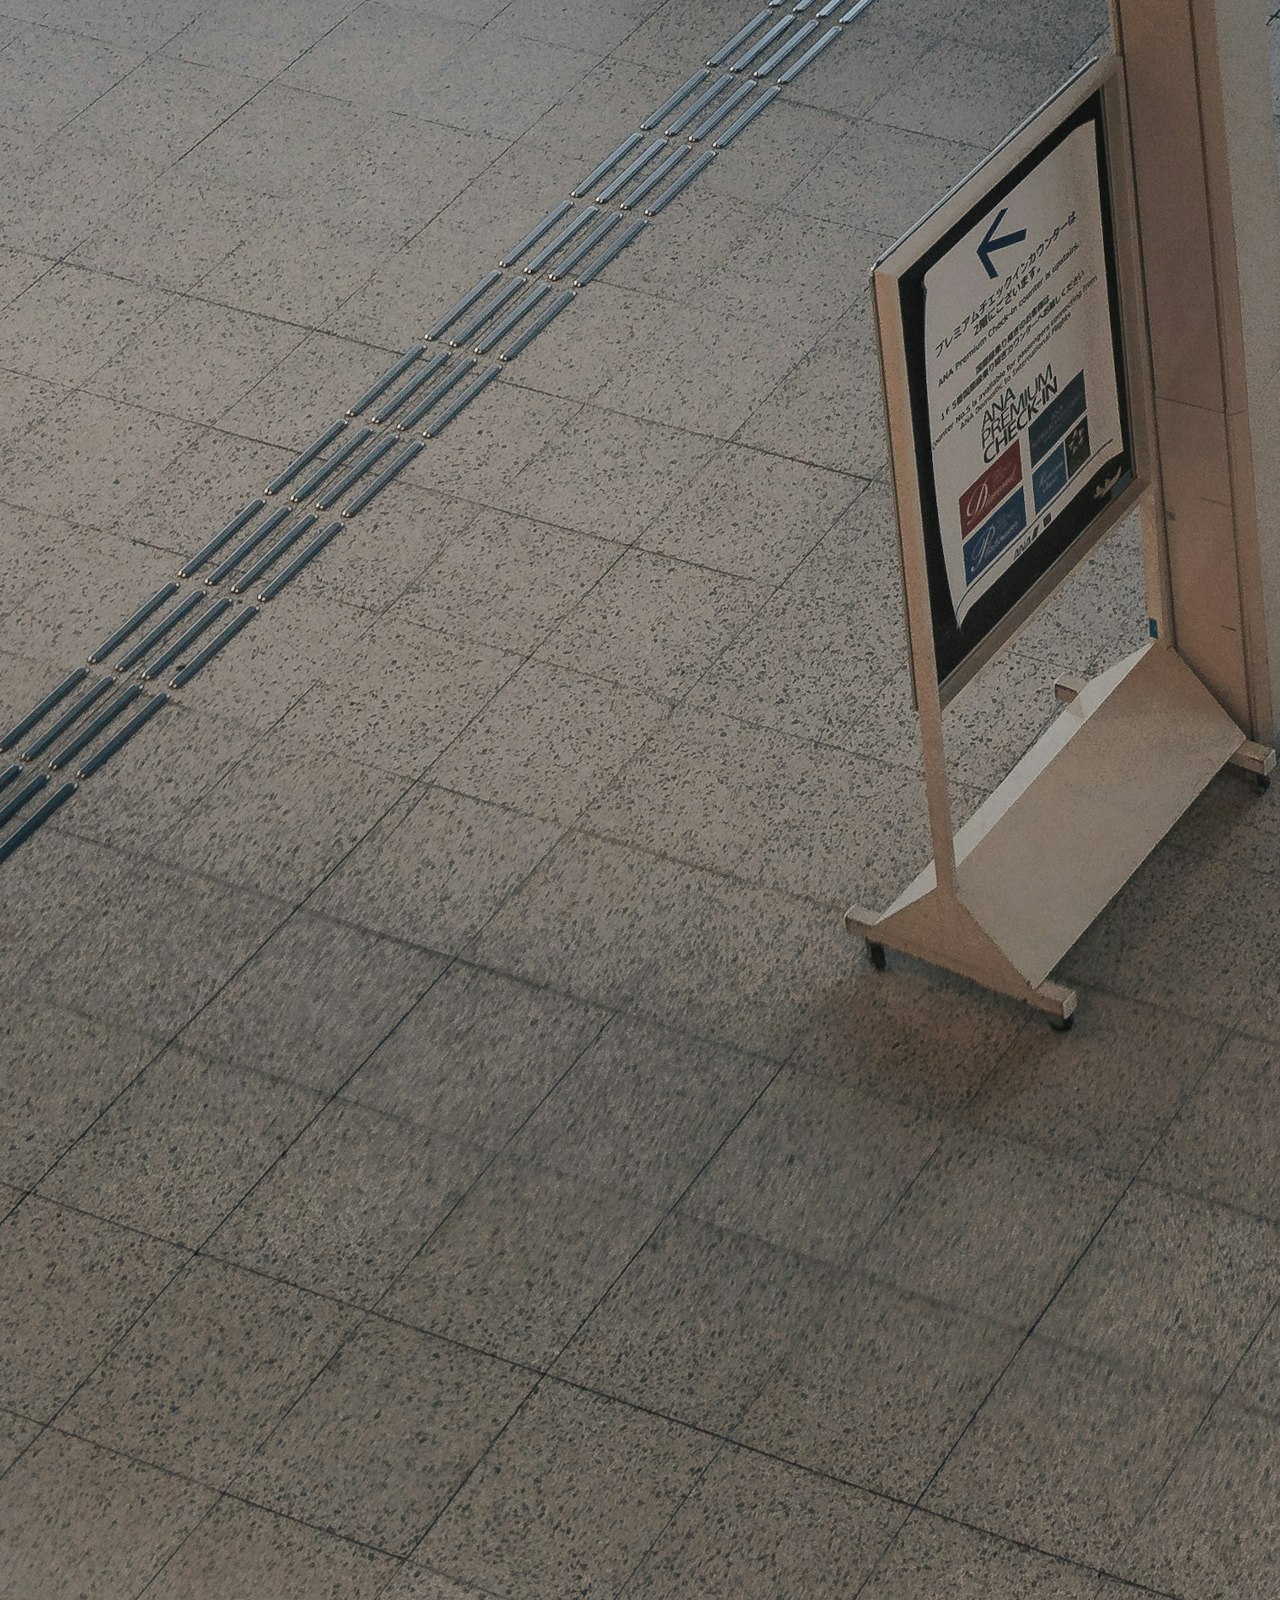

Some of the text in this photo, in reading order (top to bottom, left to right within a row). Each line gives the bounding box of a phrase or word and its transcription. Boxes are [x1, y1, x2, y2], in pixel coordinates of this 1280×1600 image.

[935, 211, 1077, 358] プレミアムチェックインカウンターは
[1006, 356, 1017, 371] for
[1082, 275, 1099, 293] from
[938, 368, 954, 388] ANA
[955, 336, 988, 371] Premium
[987, 305, 1018, 338] Check-in
[1018, 279, 1044, 307] counter
[1003, 374, 1012, 385] to
[1012, 333, 1052, 377] International
[1051, 311, 1073, 338] Flights
[981, 363, 1055, 450] PREMIUM
[982, 387, 1017, 430] ANA
[983, 376, 1059, 464] CHECK-IN
